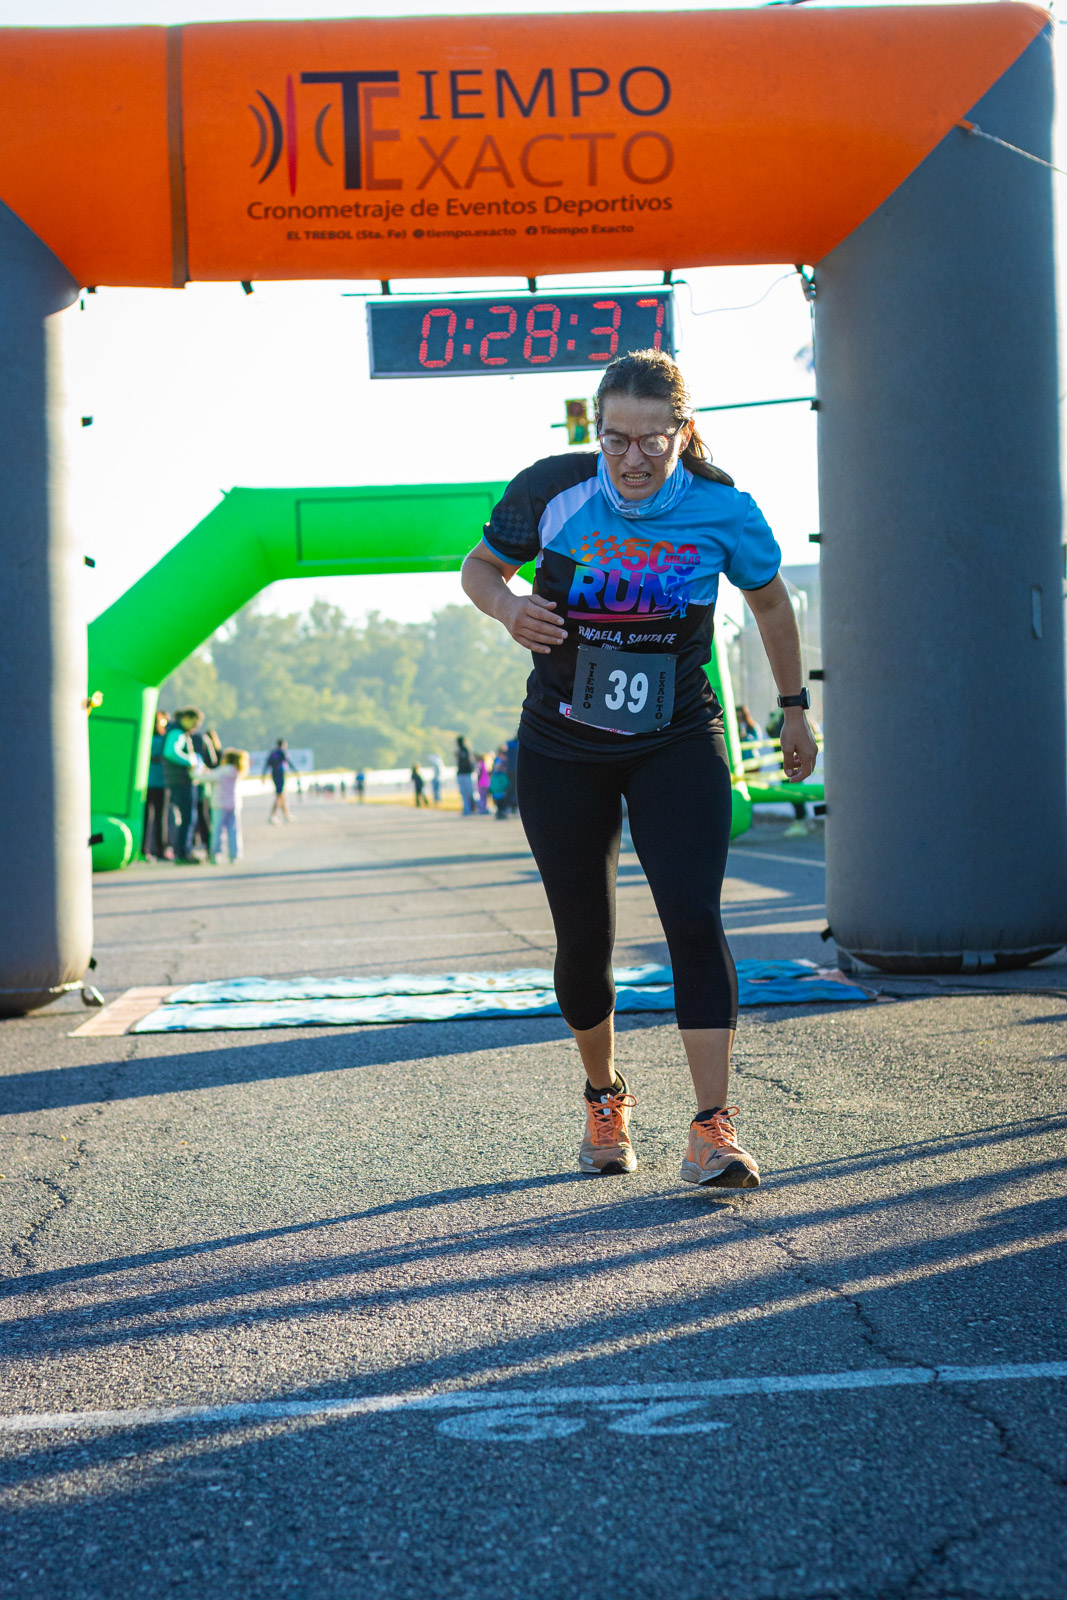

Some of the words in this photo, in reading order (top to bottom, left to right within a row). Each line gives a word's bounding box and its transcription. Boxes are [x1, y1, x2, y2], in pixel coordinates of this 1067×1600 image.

[247, 200, 405, 222] Cronometraje
[410, 198, 440, 217] de
[446, 198, 537, 217] Eventos
[544, 194, 673, 217] Deportivos
[287, 230, 301, 240] EL
[356, 229, 385, 240] (Sta.
[387, 229, 407, 239] Fe)
[540, 225, 588, 236] Tiempo
[591, 223, 634, 235] Exacto
[418, 298, 665, 369] 0:28:37
[663, 553, 701, 566] MILLAS
[567, 564, 679, 614] RUN
[578, 625, 624, 646] RAFAELA,
[627, 633, 661, 645] SANTA
[662, 633, 677, 646] FE
[583, 661, 597, 710] TIEMPO
[604, 669, 649, 714] 39
[655, 671, 667, 721] EXACTO
